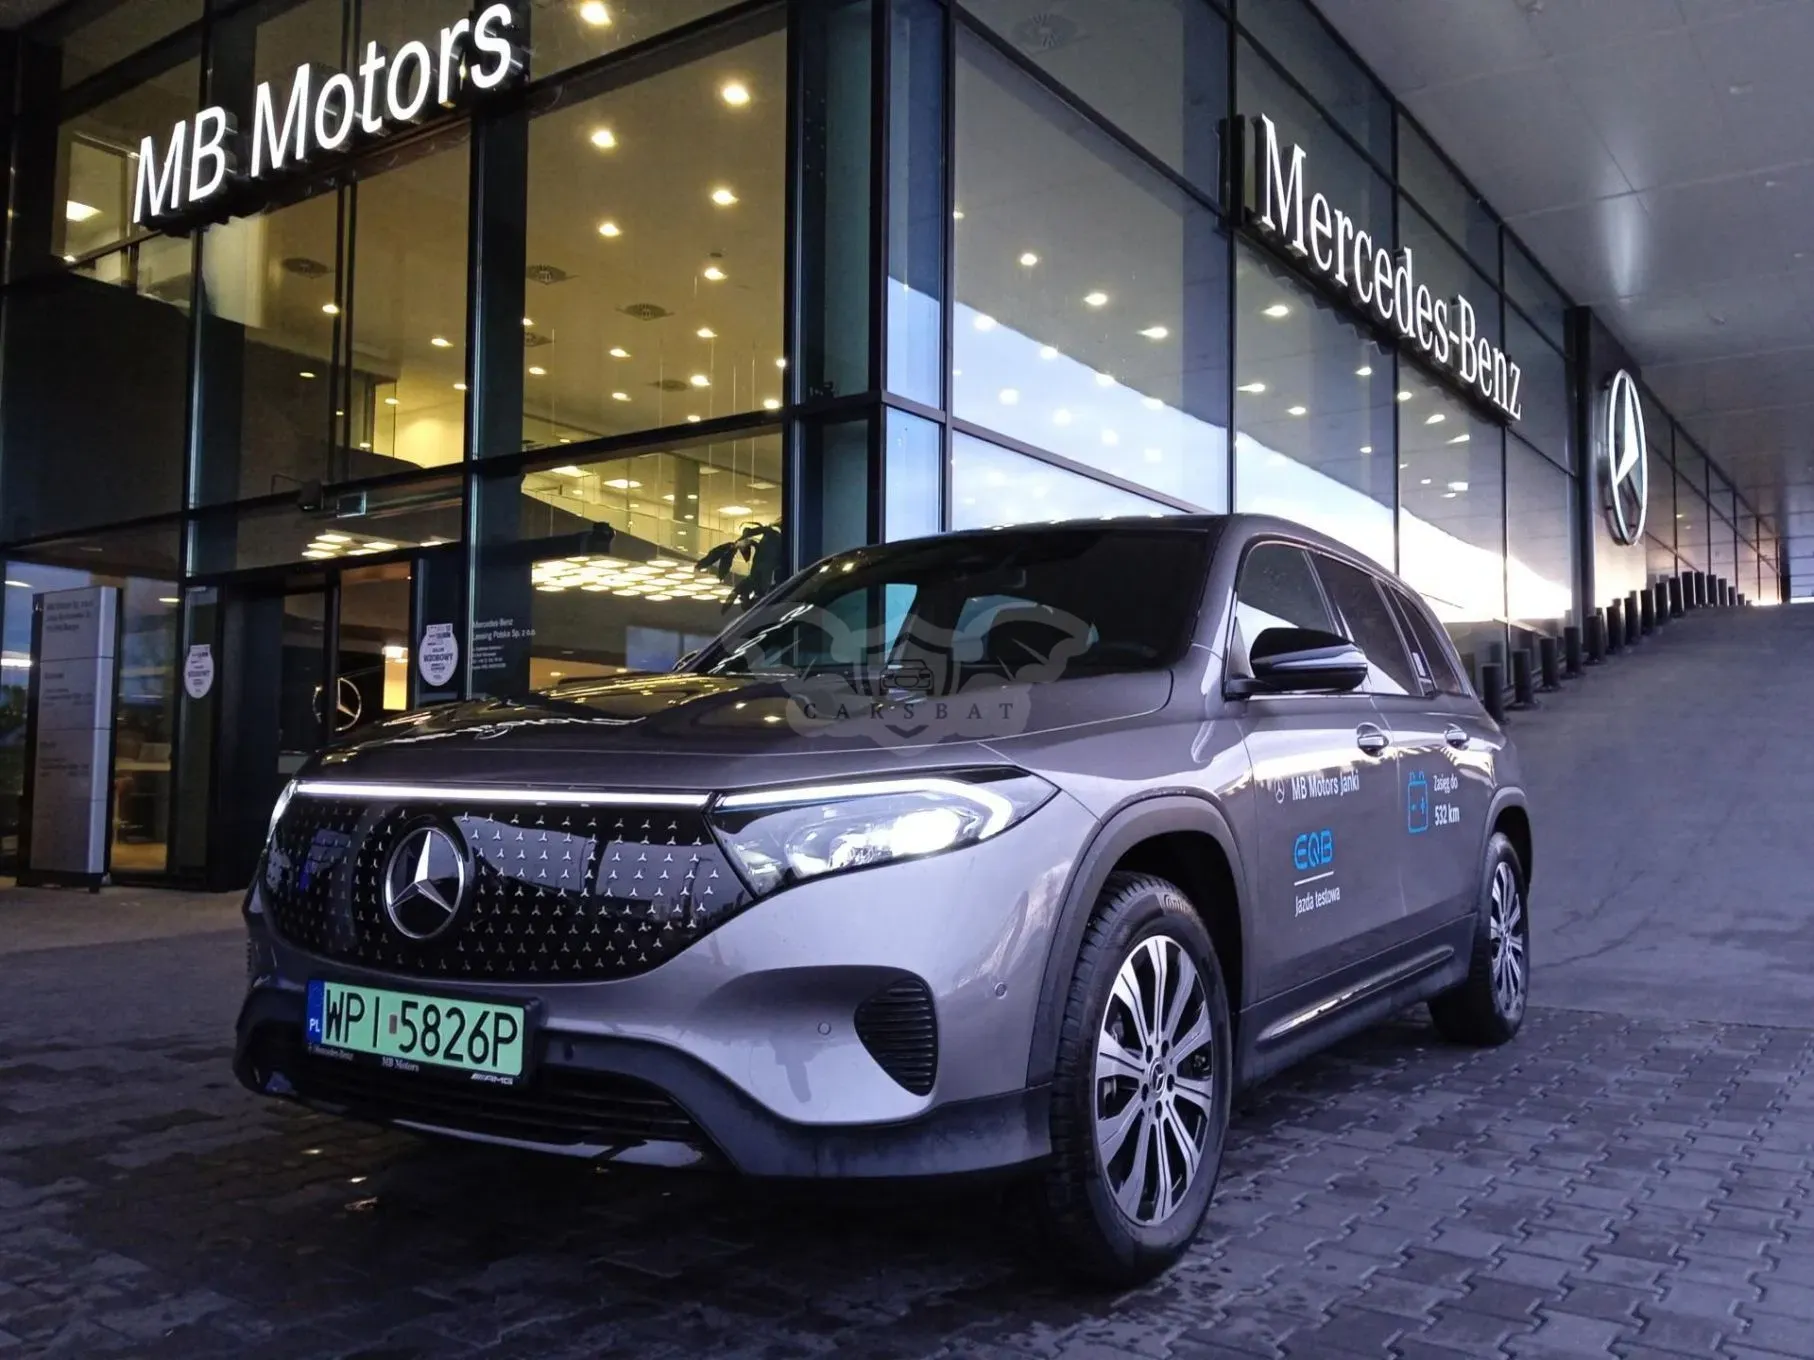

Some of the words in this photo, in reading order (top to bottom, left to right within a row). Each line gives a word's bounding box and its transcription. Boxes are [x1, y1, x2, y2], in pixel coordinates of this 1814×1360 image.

[133, 106, 228, 224] MB
[250, 3, 513, 178] Motors
[1260, 113, 1522, 421] Mercedes-Benz
[1291, 776, 1307, 801] MB
[1308, 775, 1339, 798] Motors
[1340, 769, 1360, 797] Janki
[1450, 773, 1459, 790] do
[1435, 804, 1448, 826] 532
[1448, 803, 1460, 823] km
[1294, 829, 1333, 870] EQB
[1295, 891, 1314, 918] Jazda
[1315, 887, 1341, 908] testowa
[309, 1018, 321, 1033] PL
[398, 1000, 519, 1068] 5826P
[381, 1056, 394, 1069] MB
[394, 1058, 420, 1073] Motors
